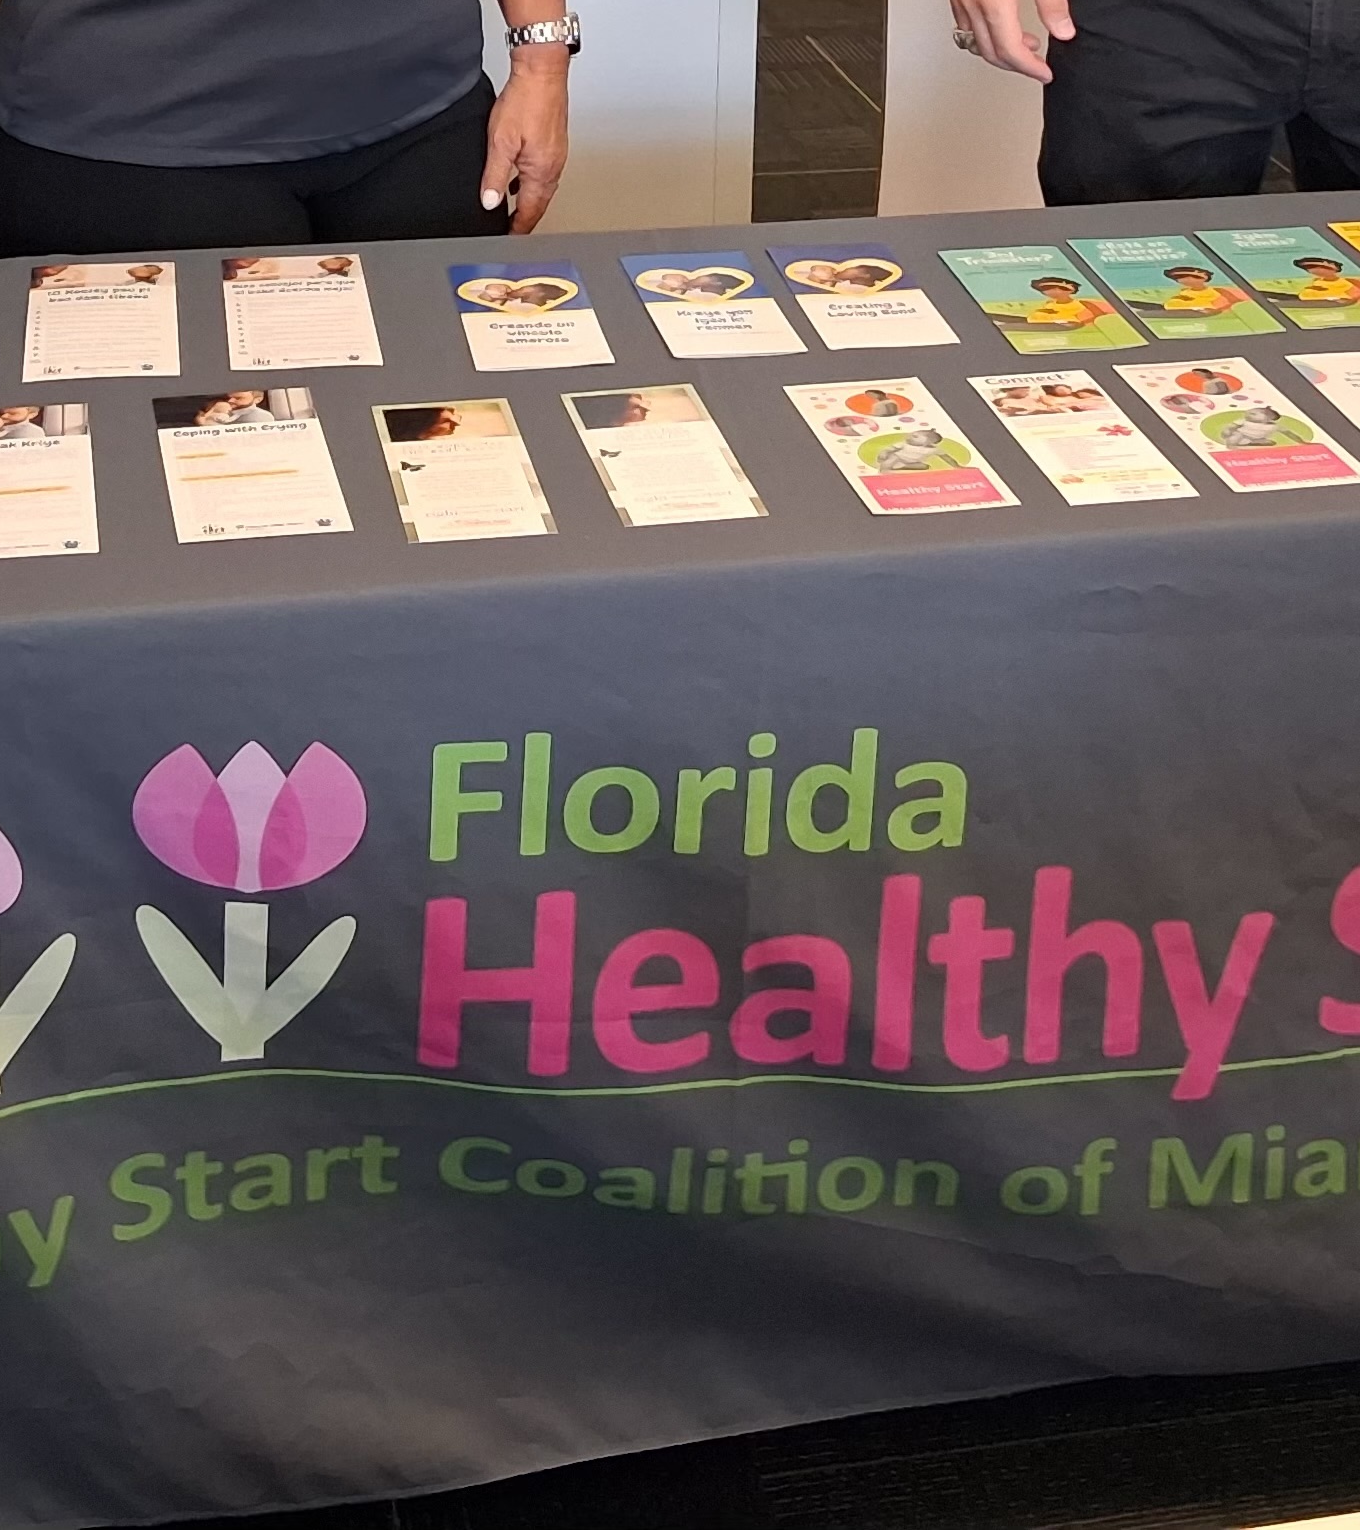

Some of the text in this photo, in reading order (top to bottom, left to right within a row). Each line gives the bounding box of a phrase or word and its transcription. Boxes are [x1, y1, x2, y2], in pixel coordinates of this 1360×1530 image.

[828, 302, 893, 311] Creating
[984, 373, 1065, 386] Connect
[173, 422, 308, 439] Coping with Crying
[1224, 453, 1333, 468] Healthy Start
[876, 481, 988, 497] Healthy Start
[428, 727, 970, 861] Florida
[416, 866, 1274, 1102] Healthy
[108, 1133, 401, 1243] Start
[437, 1135, 959, 1216] Coalition
[998, 1135, 1117, 1217] of
